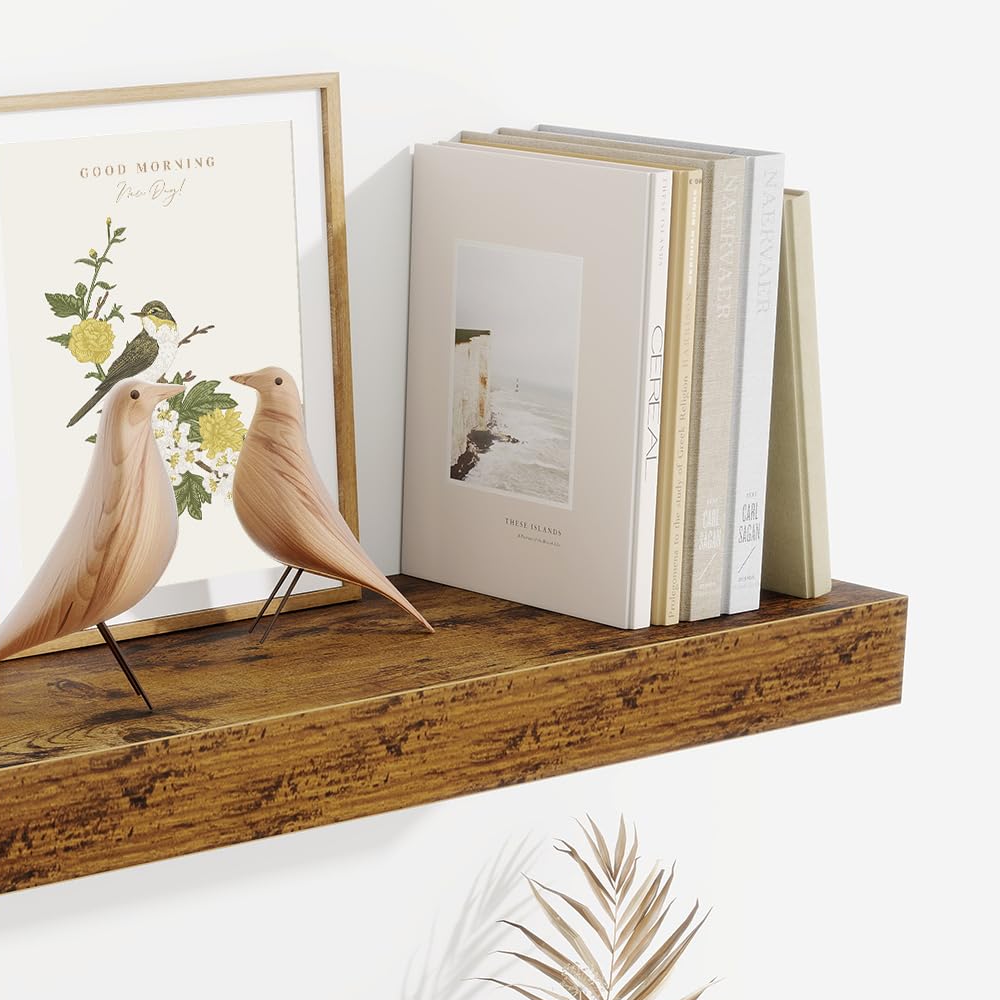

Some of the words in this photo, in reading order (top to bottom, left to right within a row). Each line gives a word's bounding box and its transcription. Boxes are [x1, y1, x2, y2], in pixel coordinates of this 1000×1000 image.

[80, 164, 126, 178] GOOD
[136, 156, 215, 173] MORNING
[645, 325, 663, 480] CEREAL
[674, 535, 682, 545] to
[680, 375, 690, 421] Religion
[742, 502, 759, 522] CARL
[505, 518, 528, 529] THESE
[530, 523, 562, 536] ISLANDS
